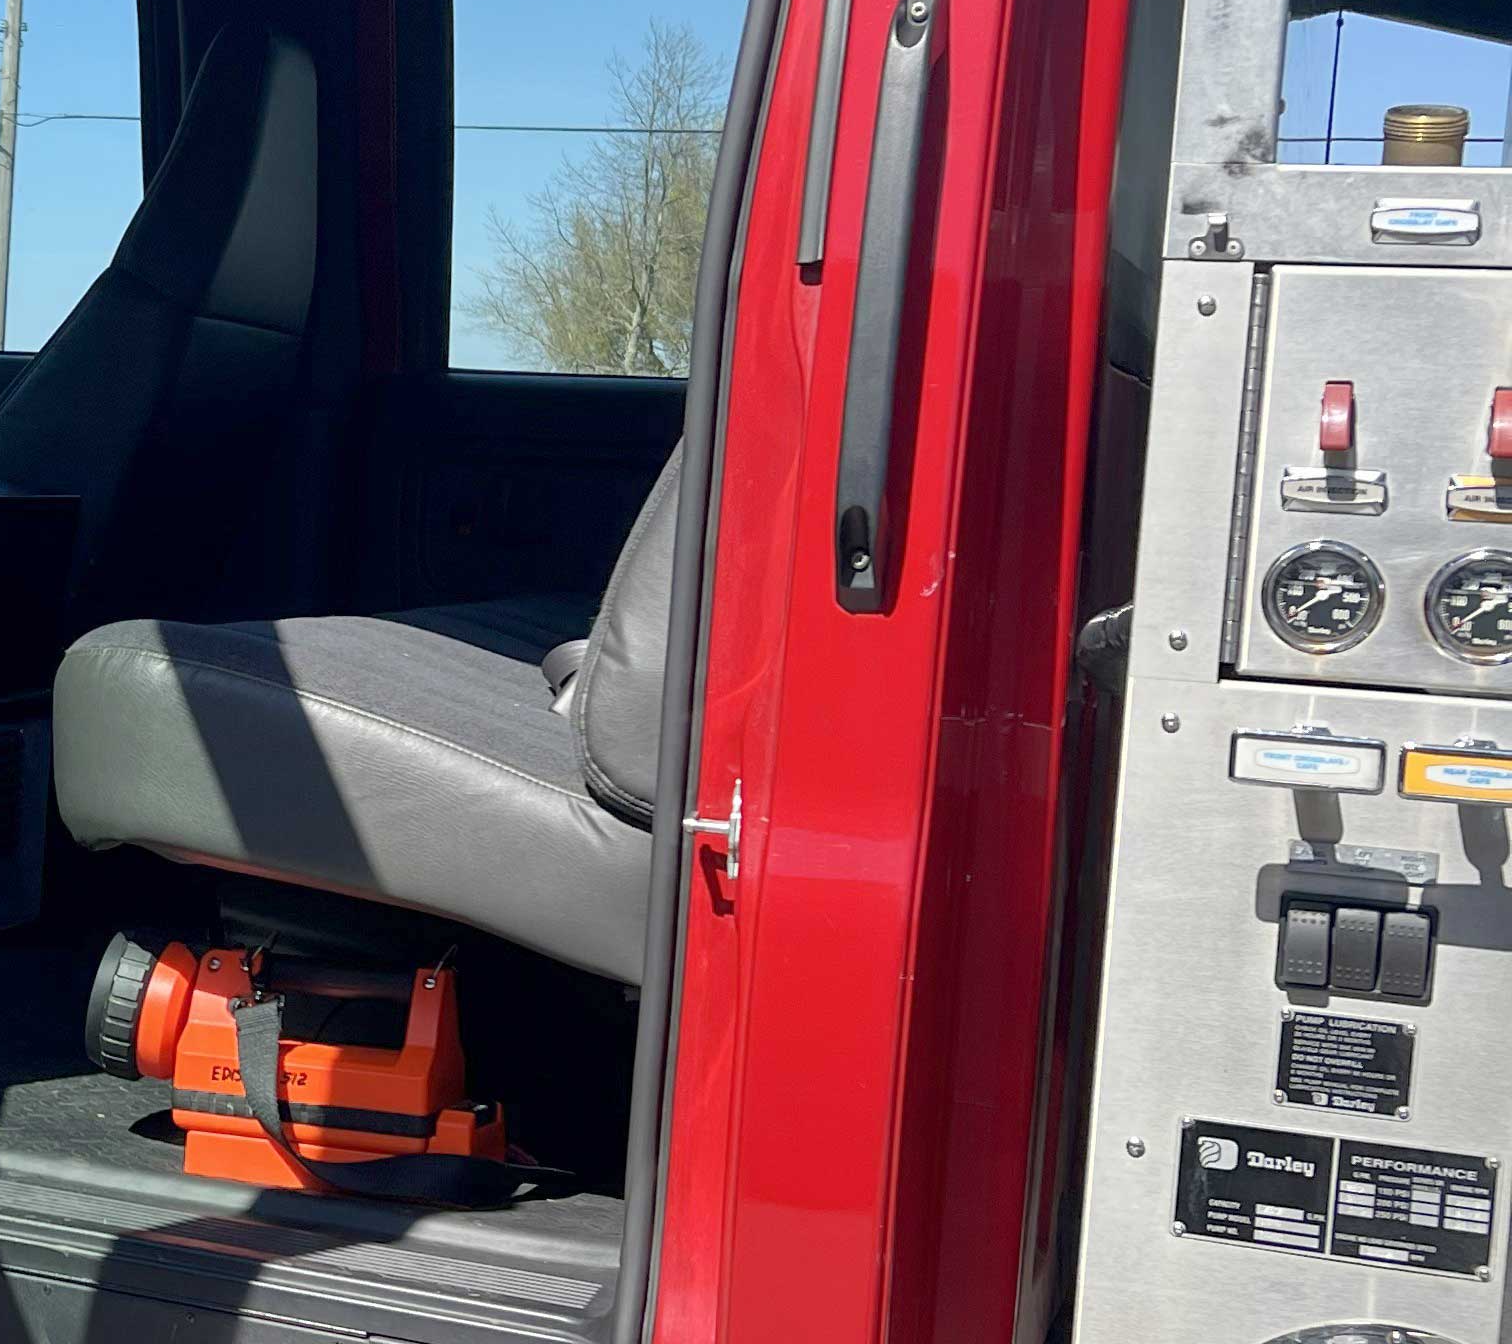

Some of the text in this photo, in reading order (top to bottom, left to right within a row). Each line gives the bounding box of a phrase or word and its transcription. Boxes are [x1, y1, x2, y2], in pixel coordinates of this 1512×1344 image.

[1295, 1015, 1326, 1025] PUMP
[1246, 1150, 1316, 1178] Darley
[1350, 1155, 1479, 1182] PERFORMANCE
